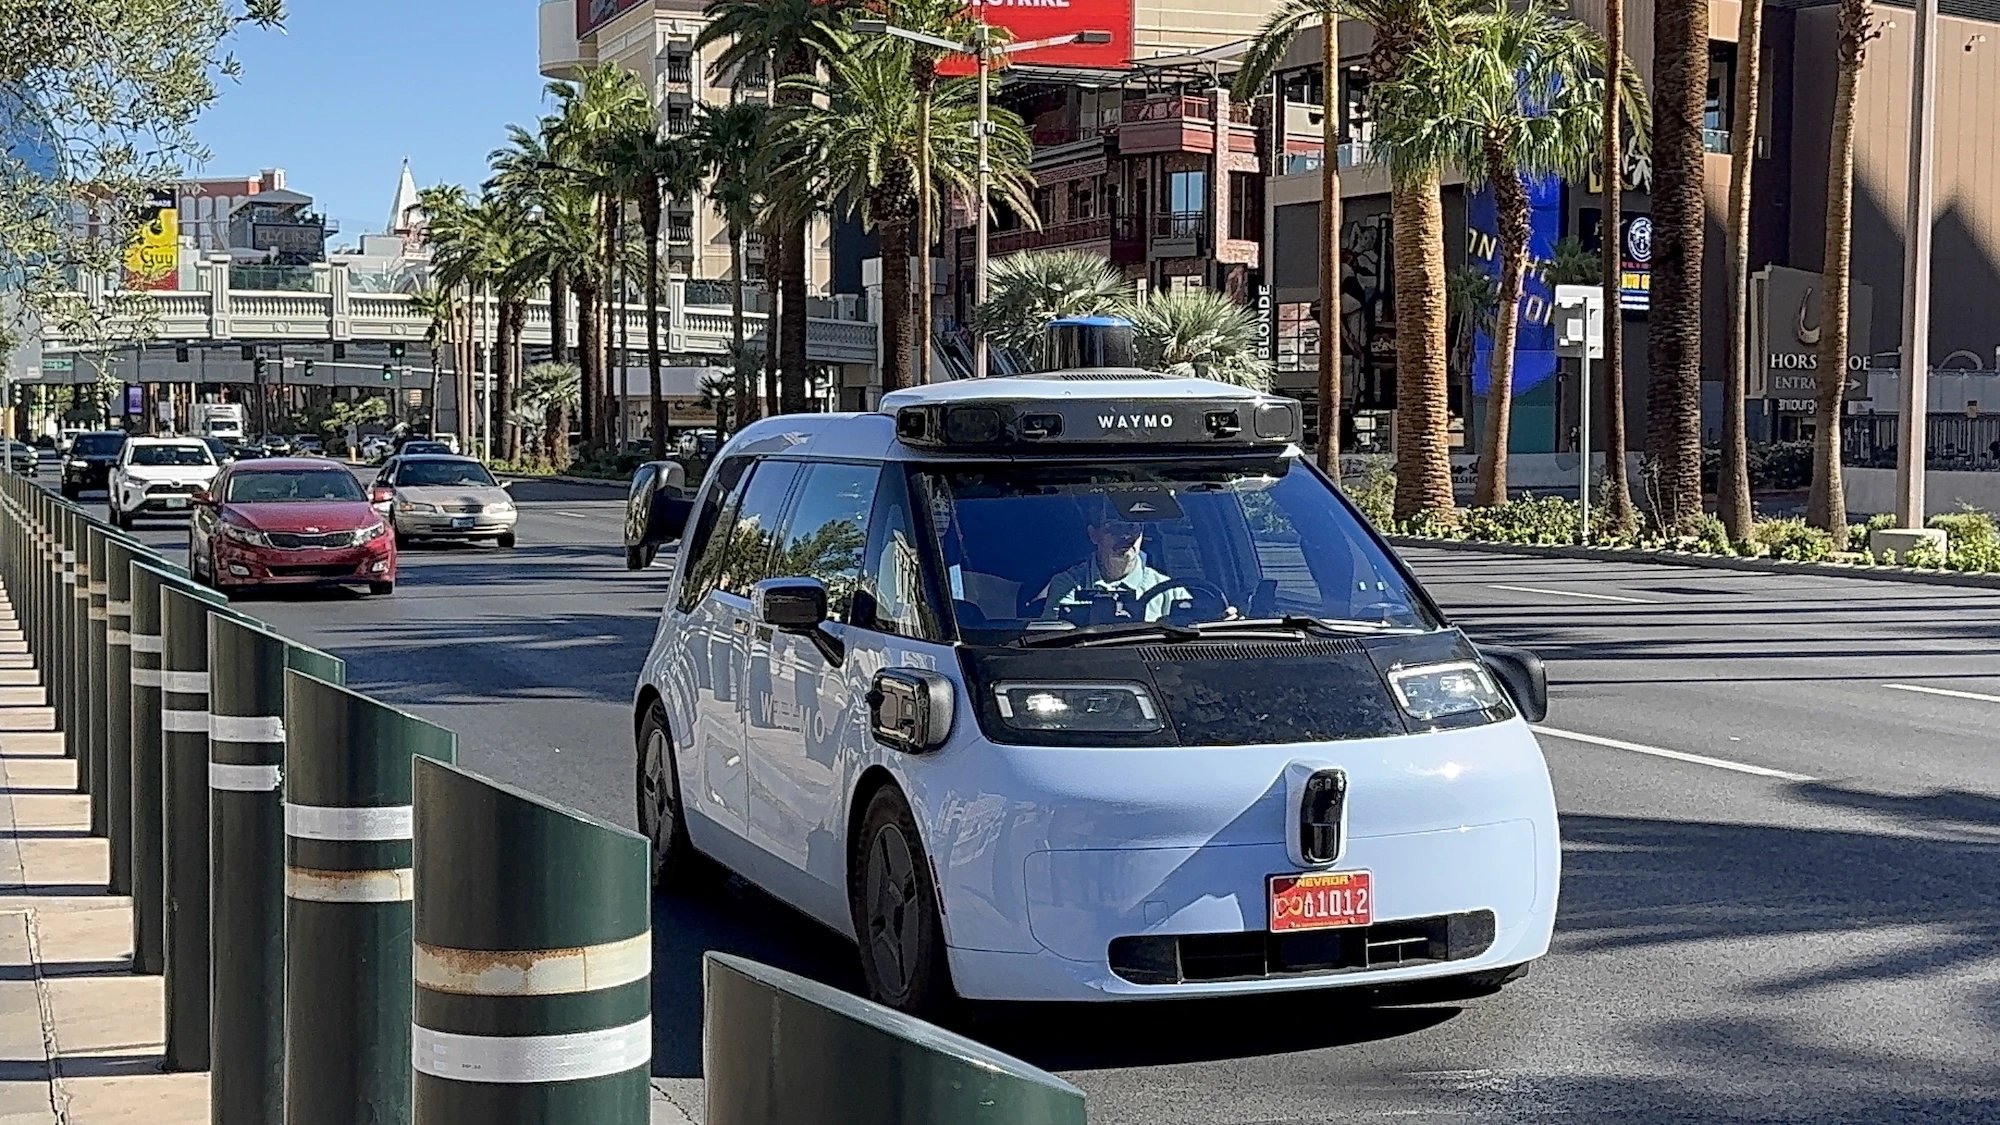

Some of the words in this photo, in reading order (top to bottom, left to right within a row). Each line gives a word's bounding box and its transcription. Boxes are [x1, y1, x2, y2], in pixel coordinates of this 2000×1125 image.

[1258, 284, 1270, 361] BLONDE
[1770, 353, 1871, 370] HORSOE
[1775, 376, 1817, 390] ENTRA
[1097, 414, 1173, 429] WAYMO
[760, 690, 826, 744] WMO
[1296, 875, 1349, 888] NEVADA
